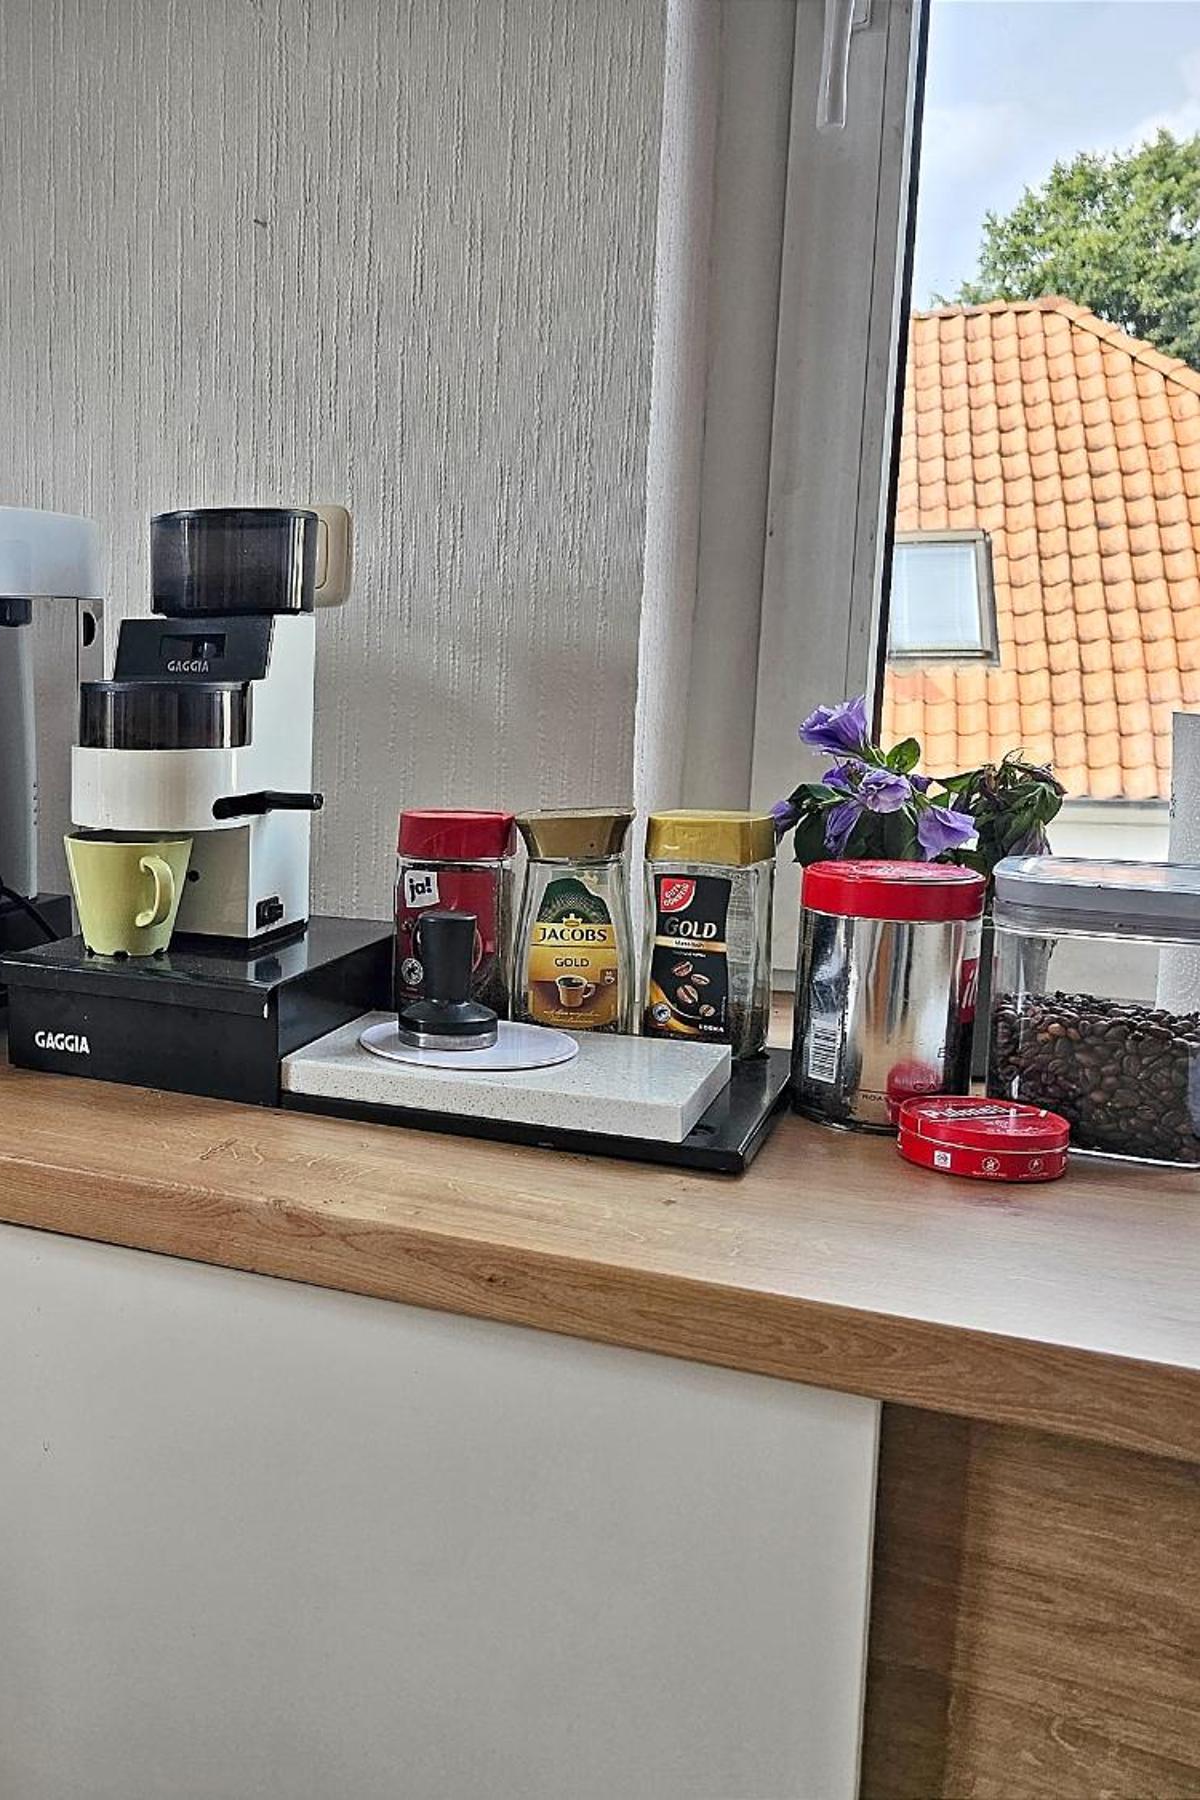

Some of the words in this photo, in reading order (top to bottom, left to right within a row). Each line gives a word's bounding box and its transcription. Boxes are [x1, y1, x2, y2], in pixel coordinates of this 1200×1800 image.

[167, 660, 209, 672] GAGGIA
[409, 876, 433, 903] ja!
[539, 927, 608, 942] JACOBS
[664, 916, 718, 938] GOLD
[554, 957, 590, 967] GOLD
[34, 1030, 91, 1055] GAGGIA
